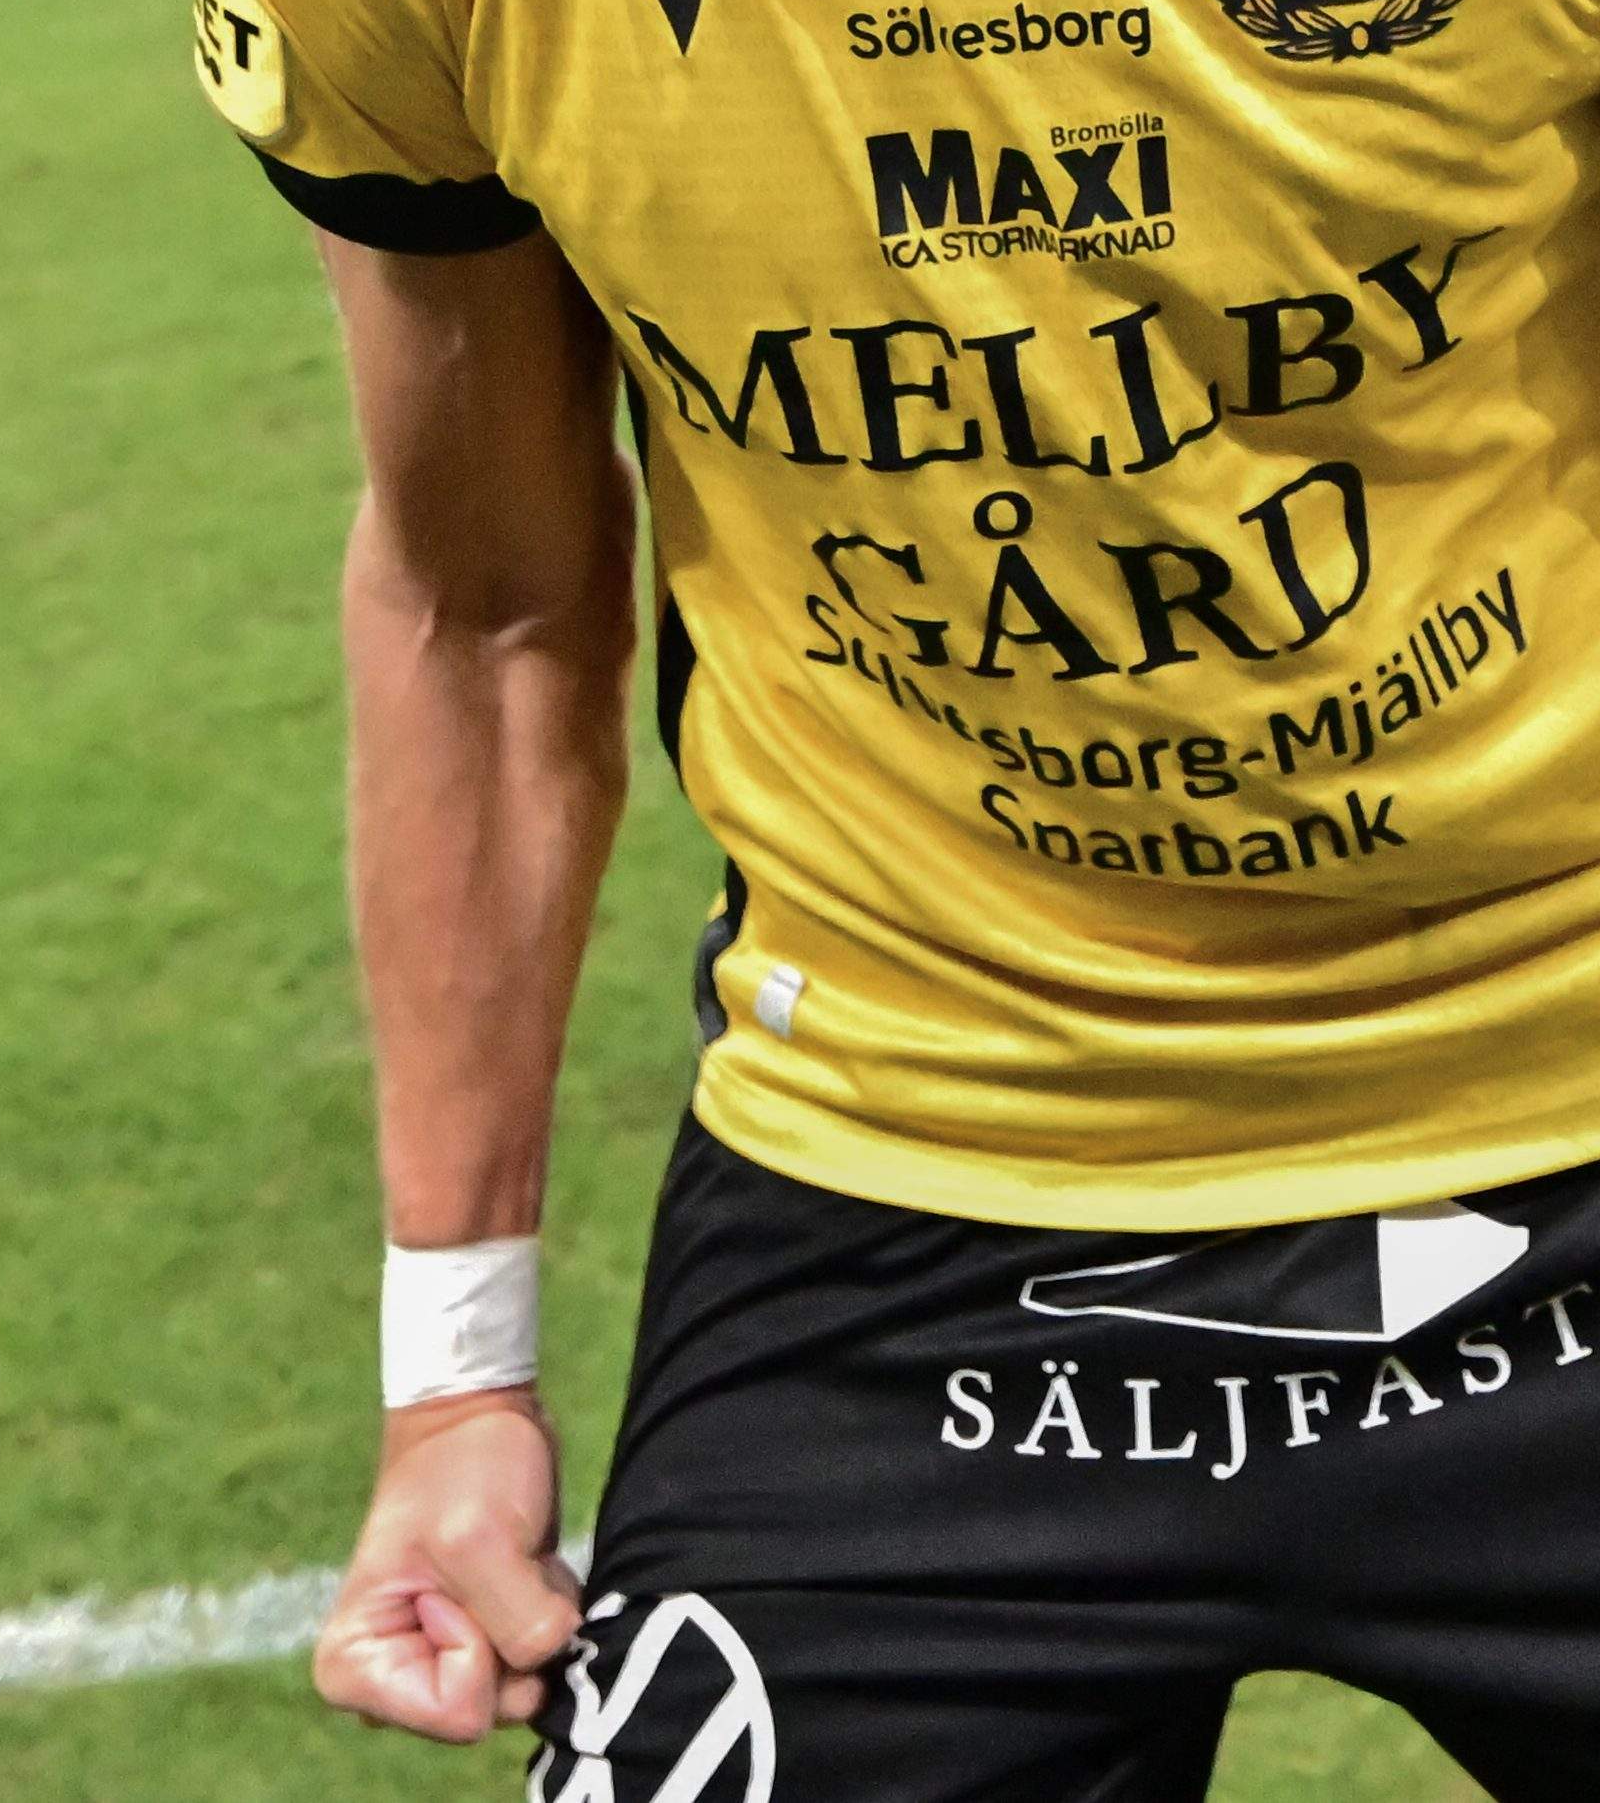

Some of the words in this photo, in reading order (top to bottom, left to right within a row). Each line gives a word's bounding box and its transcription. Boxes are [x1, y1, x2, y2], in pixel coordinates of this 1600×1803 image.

[865, 129, 1172, 238] MAXI
[1050, 112, 1165, 148] Bromölla
[627, 225, 1506, 476] MELLBY
[812, 460, 1373, 682] GÅRD
[940, 1281, 1595, 1481] SÄLJFAST
